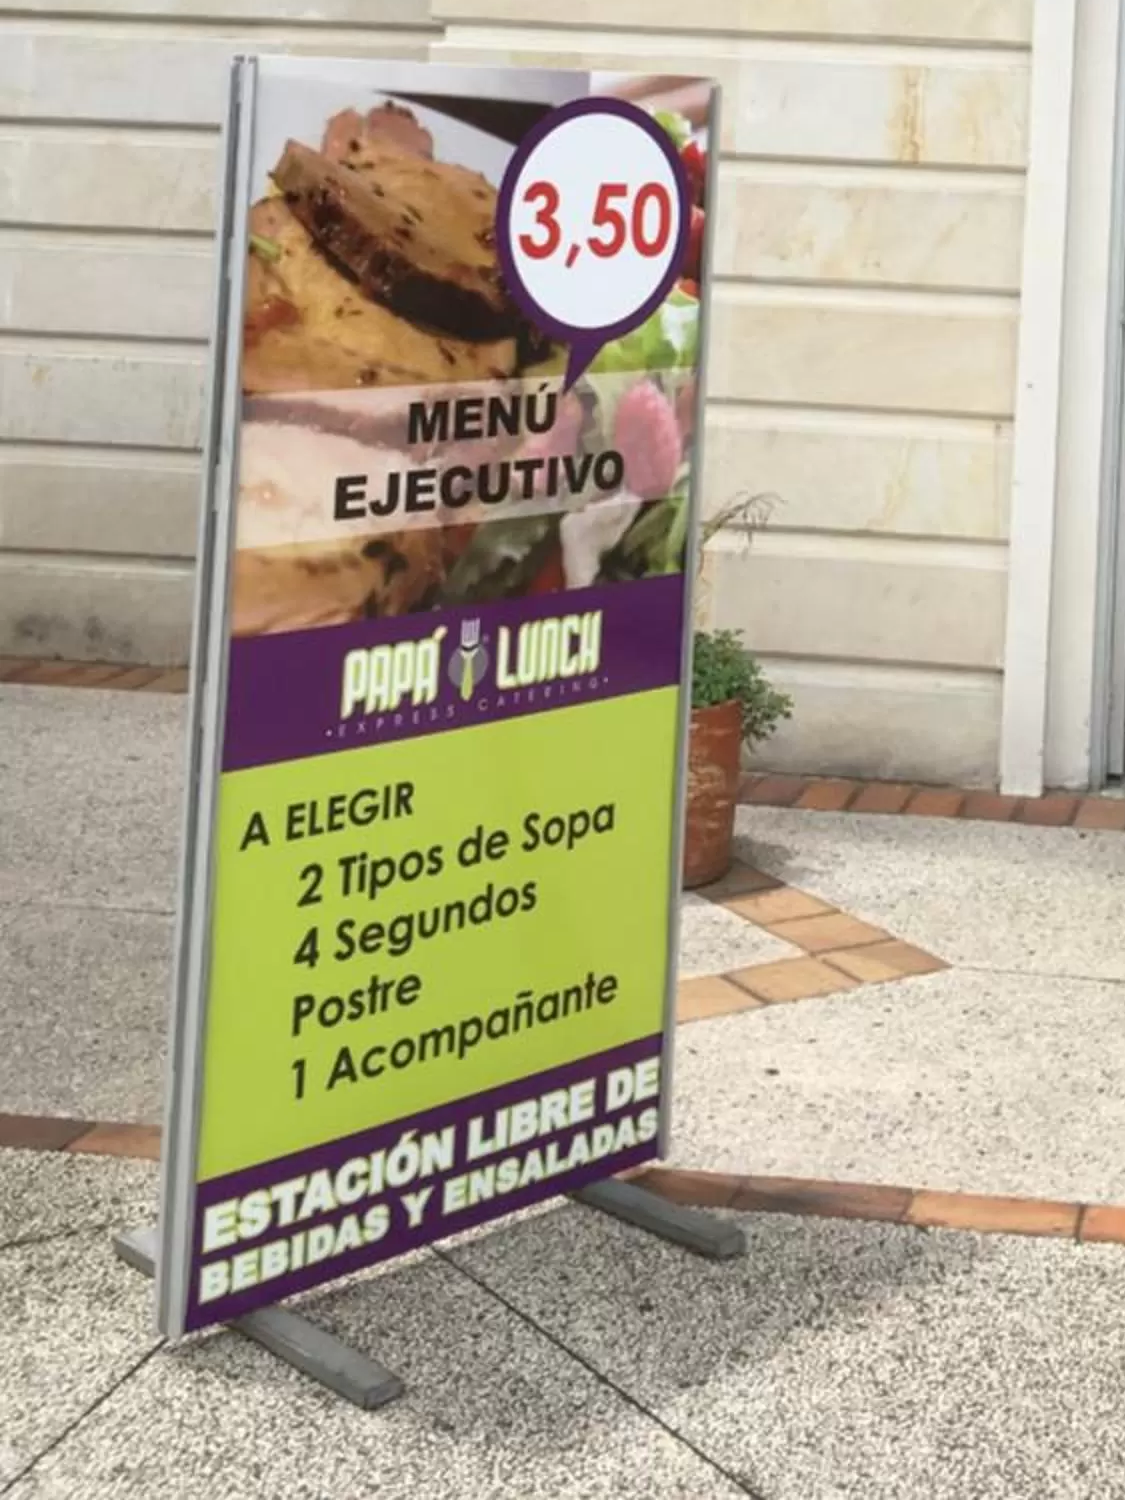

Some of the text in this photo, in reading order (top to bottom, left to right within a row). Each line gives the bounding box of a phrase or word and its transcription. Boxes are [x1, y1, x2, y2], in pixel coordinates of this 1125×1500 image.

[518, 181, 673, 268] 3,50
[406, 381, 559, 445] MENÚ
[333, 450, 625, 521] EJECUTIVO
[340, 609, 603, 720] PAPÁ LUNCH
[239, 781, 416, 851] A ELEGIR
[296, 801, 617, 907] 2 Tipos de Sopa
[293, 880, 538, 969] 4 Segundos
[291, 974, 422, 1037] Postre
[292, 971, 619, 1100] 1 Acompañante
[202, 1056, 661, 1253] ESTACIÓN LIBRE DE
[199, 1107, 659, 1305] BEBIDAS Y ENSALADAS
